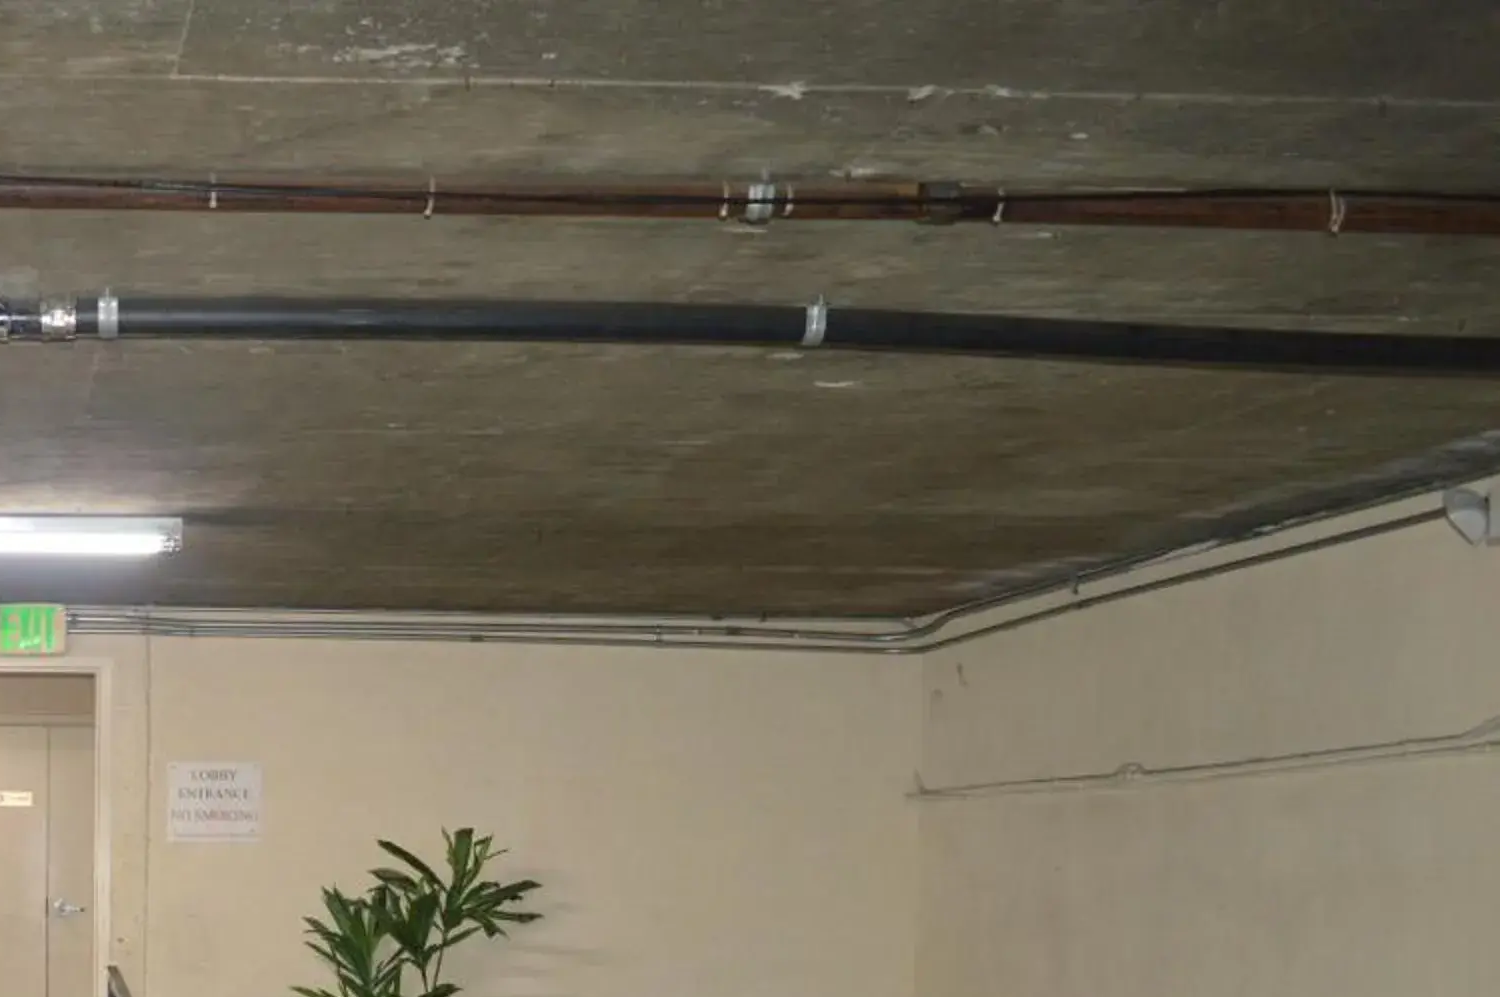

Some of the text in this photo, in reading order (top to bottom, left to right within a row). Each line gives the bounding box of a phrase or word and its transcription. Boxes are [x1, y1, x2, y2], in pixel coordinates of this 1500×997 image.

[189, 770, 238, 782] LOBBY
[178, 789, 250, 801] ENTRANCE
[173, 810, 193, 822] NO
[196, 809, 259, 823] SMOKING
